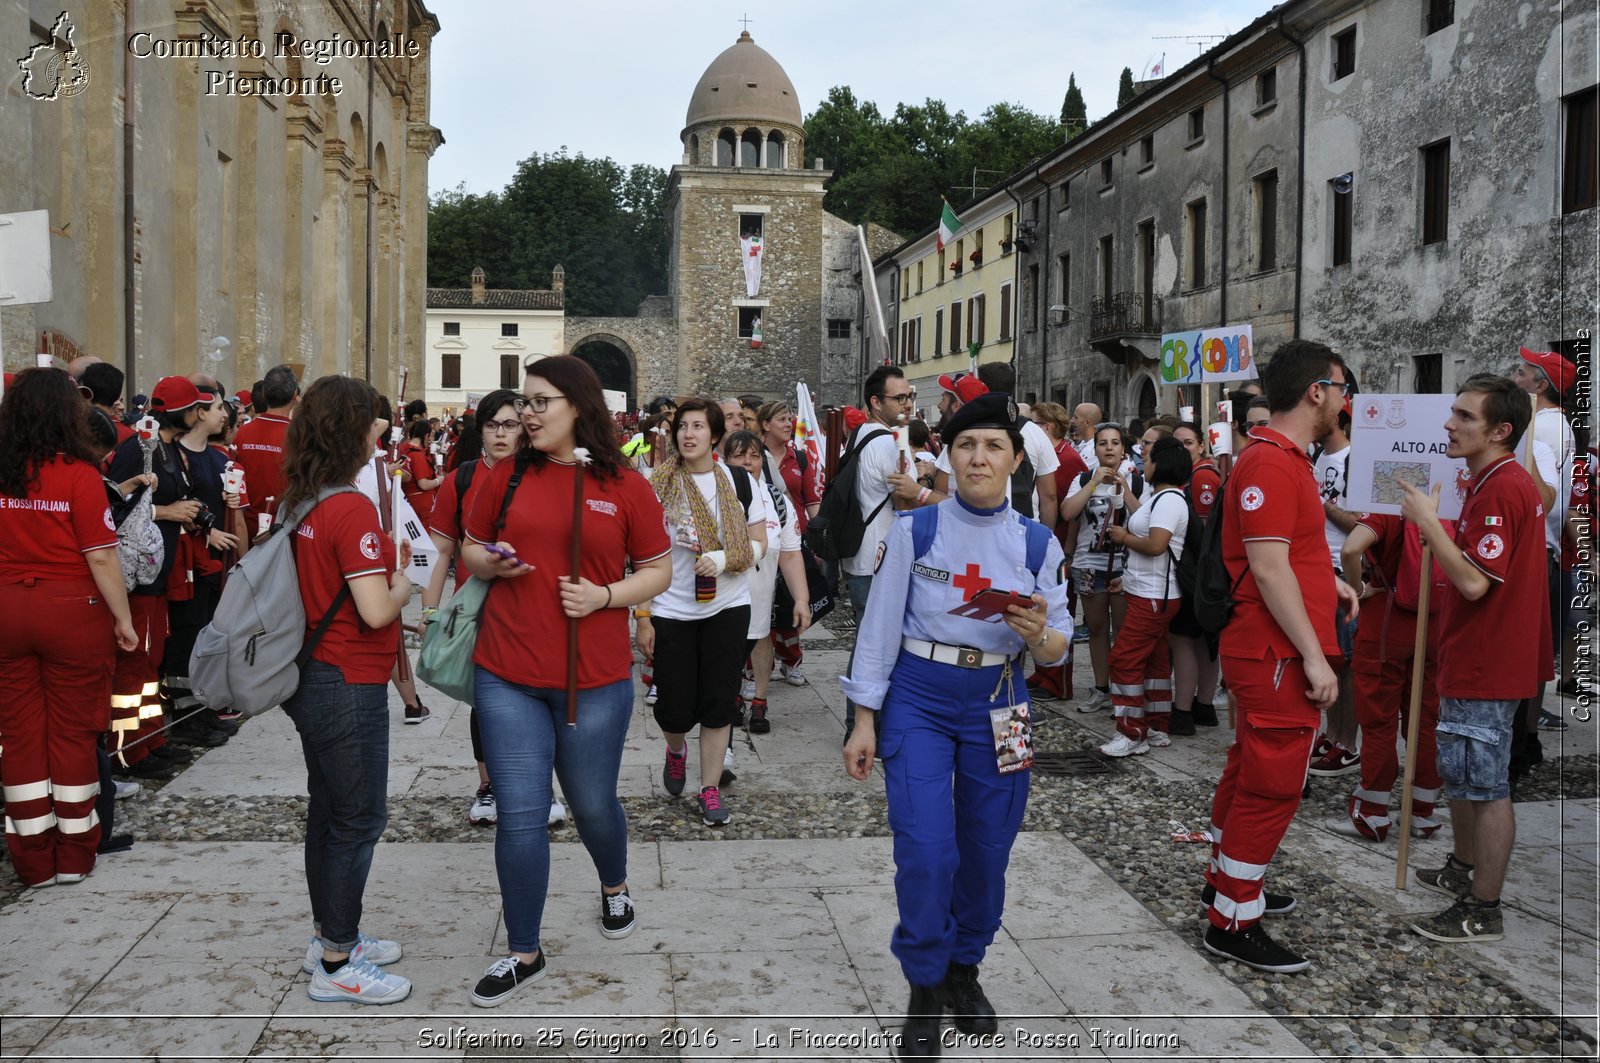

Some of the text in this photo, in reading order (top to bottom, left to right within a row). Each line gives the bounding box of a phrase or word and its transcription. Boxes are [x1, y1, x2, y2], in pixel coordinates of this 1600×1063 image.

[1202, 334, 1250, 373] COMO
[1391, 441, 1425, 454] ALTO
[8, 498, 33, 509] ROSSA
[33, 499, 70, 512] ITALIANA
[914, 565, 948, 580] MONTIGLIO
